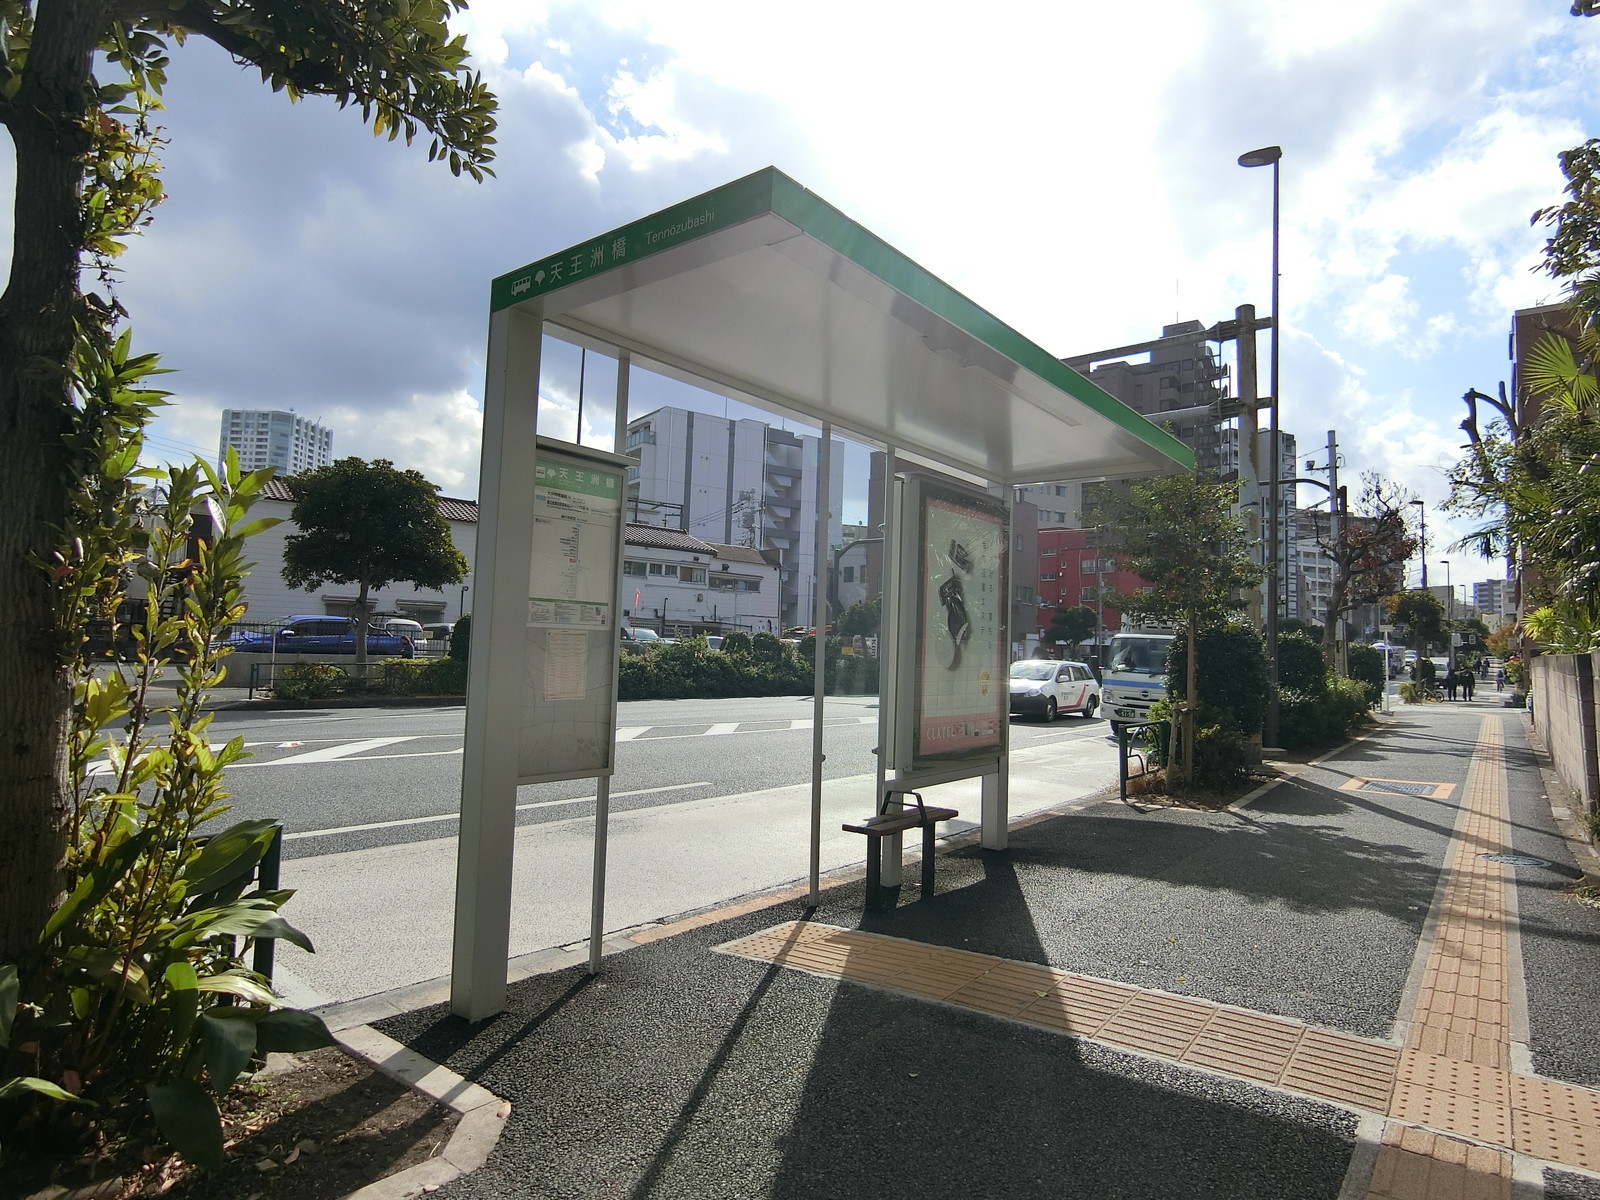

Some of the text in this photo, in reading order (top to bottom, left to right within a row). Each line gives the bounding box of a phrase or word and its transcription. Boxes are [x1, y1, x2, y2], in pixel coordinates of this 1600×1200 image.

[550, 207, 715, 283] 天王洲橋 Tennōzubashi
[559, 467, 616, 489] 天王洲橋
